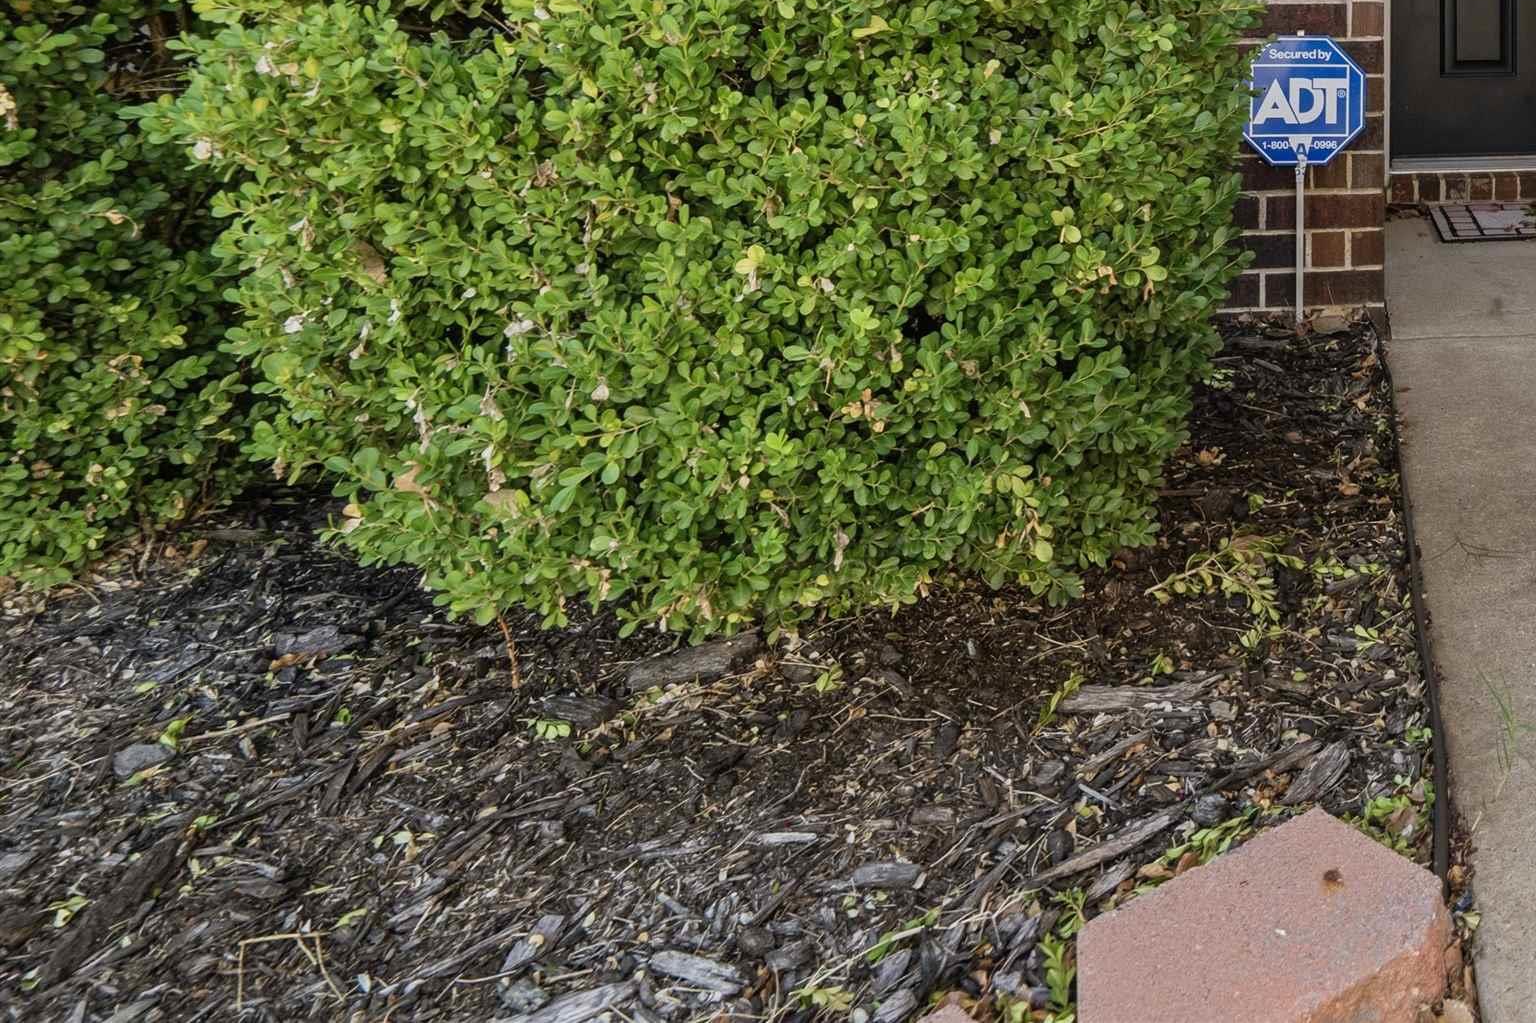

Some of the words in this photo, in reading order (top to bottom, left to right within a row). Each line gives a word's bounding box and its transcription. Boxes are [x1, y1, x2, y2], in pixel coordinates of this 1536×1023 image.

[1269, 48, 1317, 60] Secured
[1318, 48, 1332, 62] by
[1253, 77, 1347, 125] ADT
